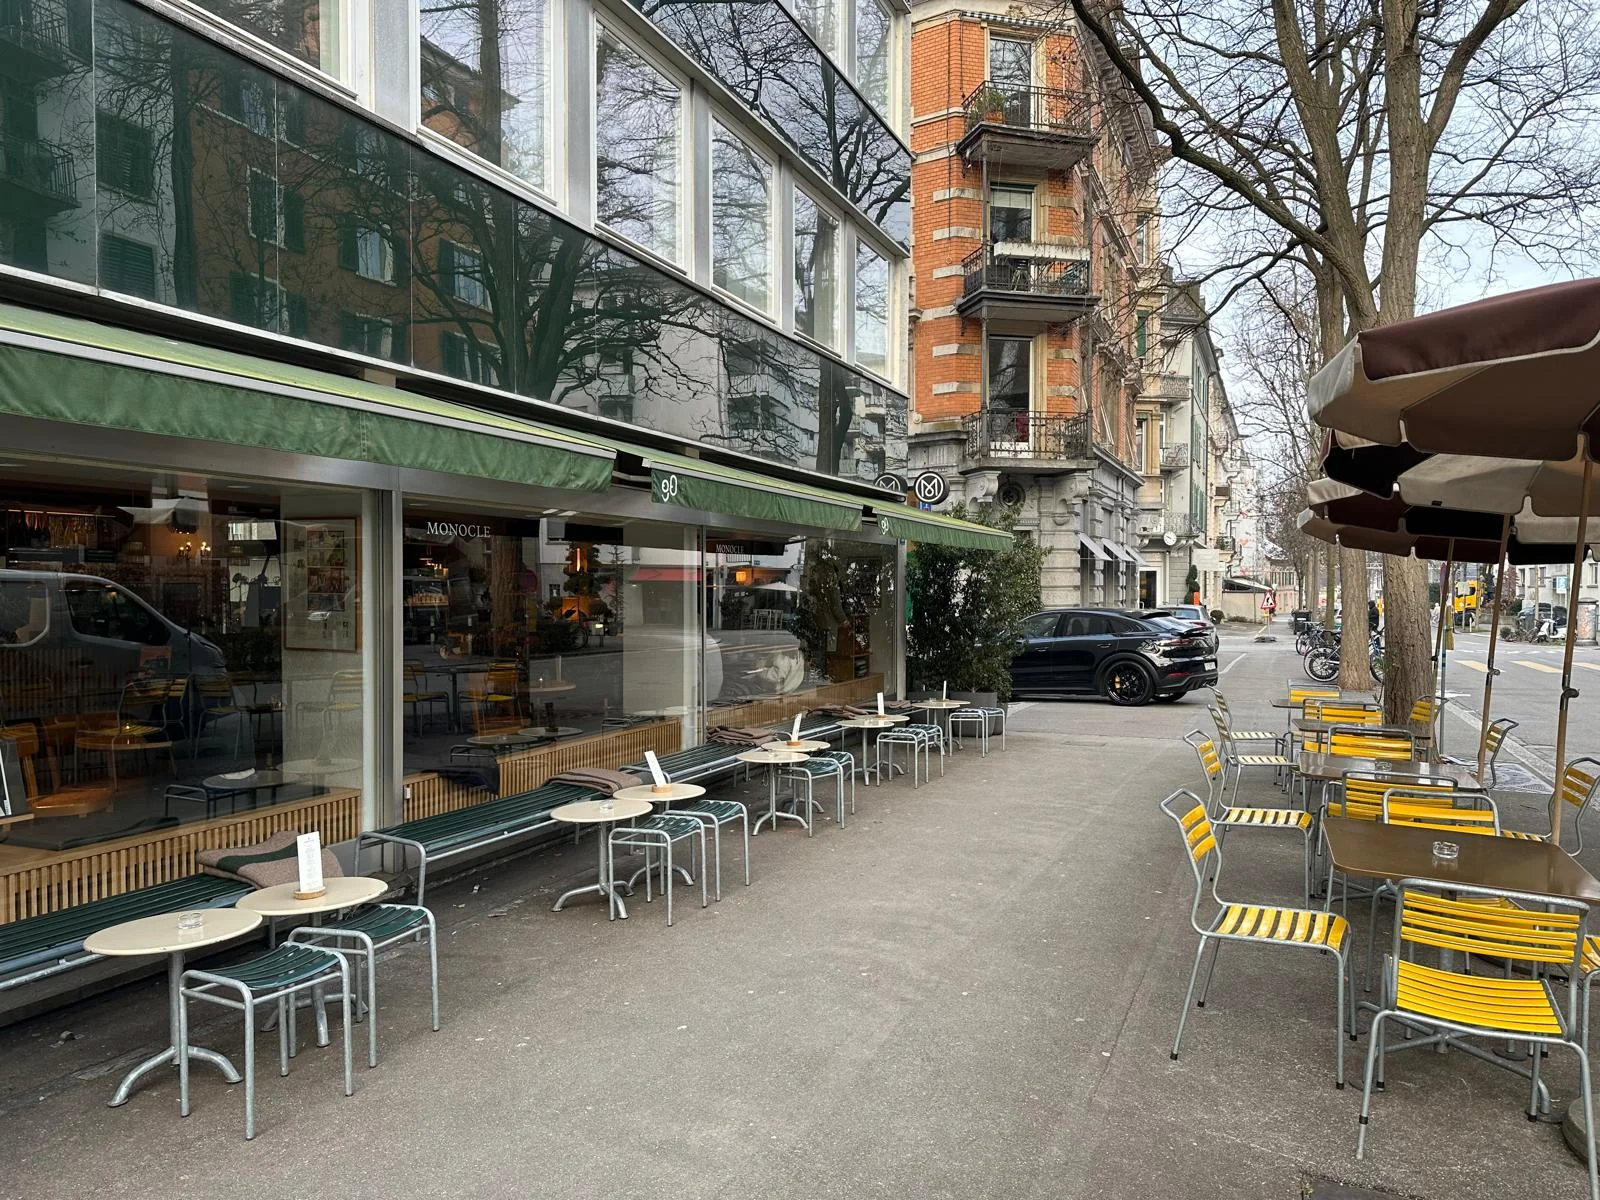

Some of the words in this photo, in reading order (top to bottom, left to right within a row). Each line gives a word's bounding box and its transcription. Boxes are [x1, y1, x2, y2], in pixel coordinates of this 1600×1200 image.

[919, 477, 940, 499] M
[426, 521, 492, 538] MONOCLE
[715, 544, 745, 554] MONOCLE
